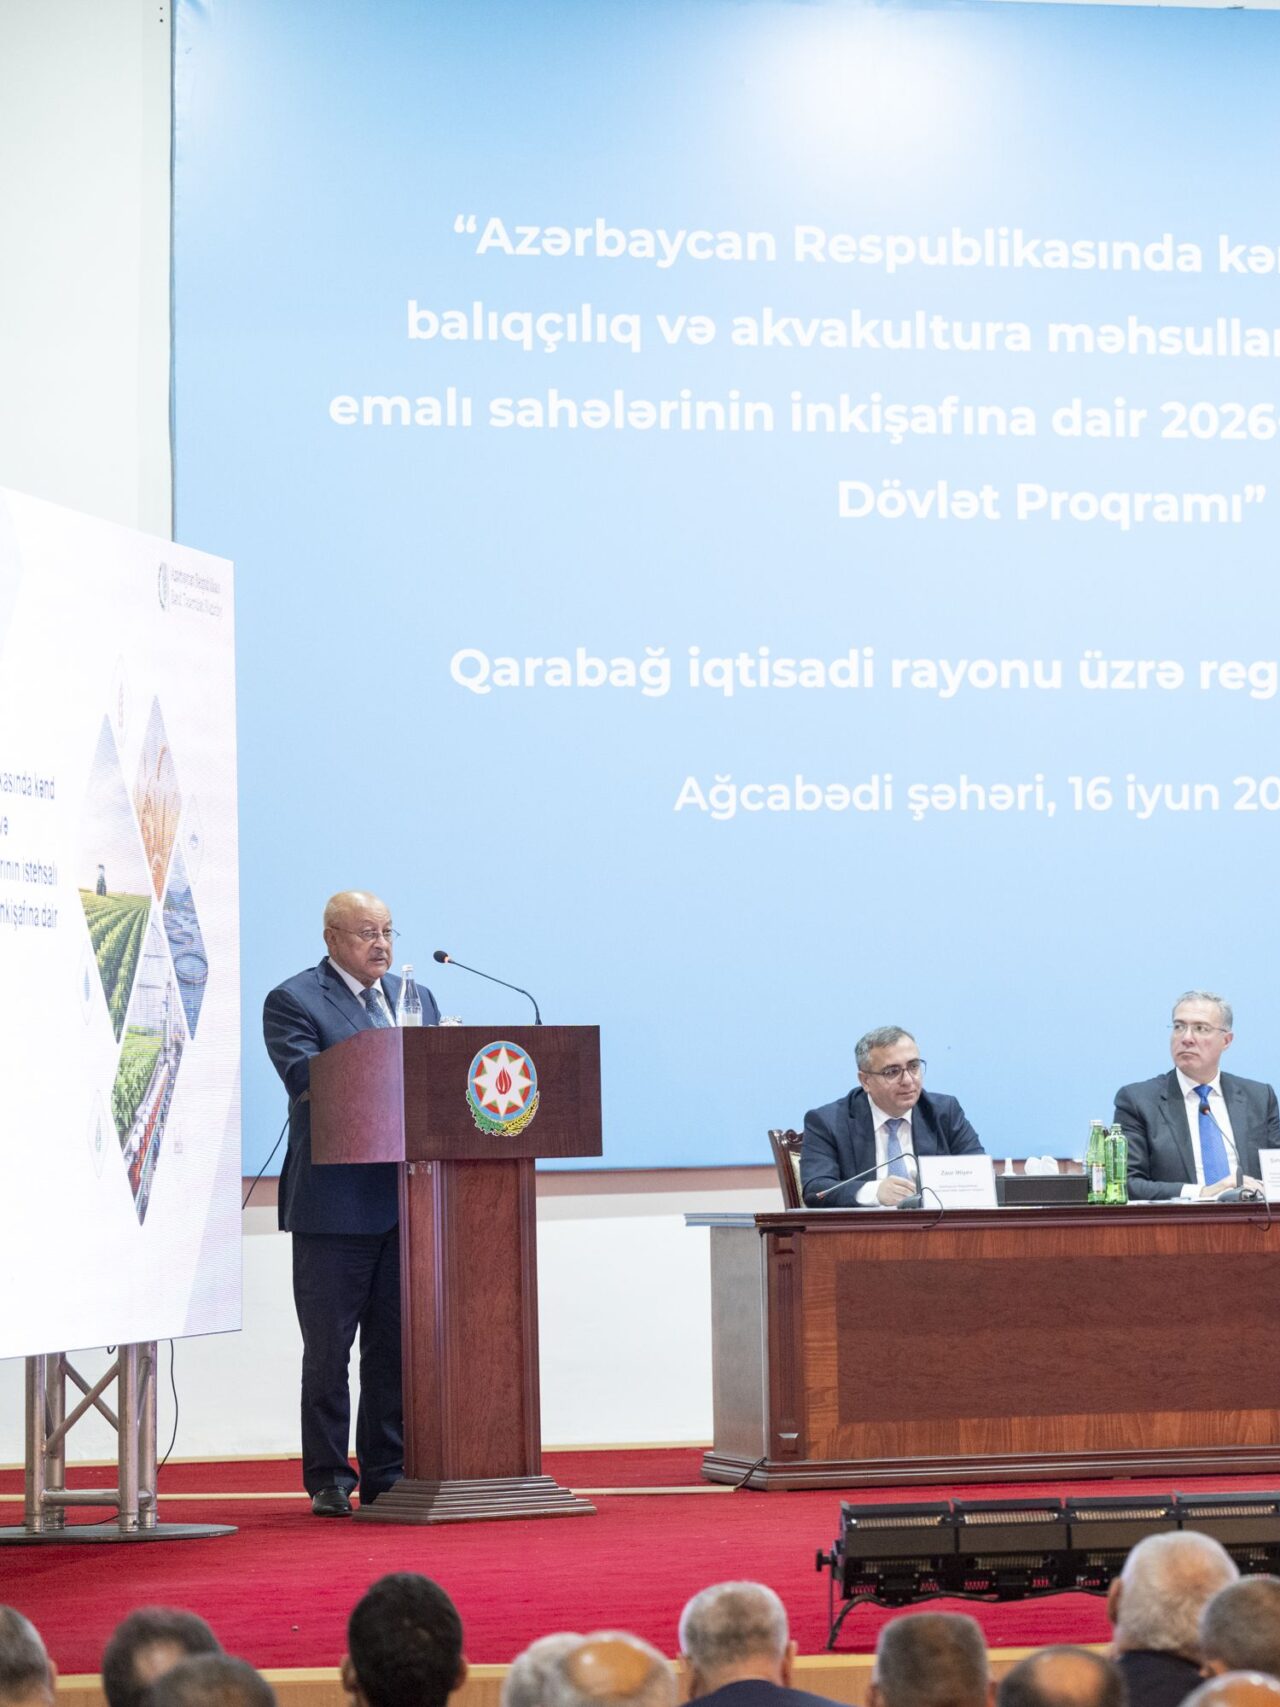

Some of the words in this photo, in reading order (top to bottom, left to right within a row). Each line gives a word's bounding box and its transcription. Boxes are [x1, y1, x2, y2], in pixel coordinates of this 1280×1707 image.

[454, 214, 776, 268] “Azərbaycan
[795, 225, 1202, 273] Respublikasında
[408, 299, 640, 353] balıqçılıq
[656, 315, 716, 345] və
[731, 308, 1031, 351] akvakultura
[329, 386, 471, 427] emalı
[489, 389, 773, 431] sahələrinin
[791, 391, 1036, 444] inkişafına
[1052, 397, 1147, 437] dair
[839, 479, 1000, 519] Dövlət
[1017, 483, 1266, 530] Proqramı”
[450, 646, 671, 697] Qarabağ
[688, 646, 874, 697] iqtisadi
[892, 659, 1062, 698] rayonu
[1080, 650, 1184, 689] üzrə
[35, 772, 55, 799] kənd
[673, 773, 892, 820] Ağcabədi
[908, 774, 1056, 821] şəhəri,
[1068, 776, 1113, 811] 16
[1126, 774, 1220, 819] iyun
[22, 857, 57, 886] istehsalı
[42, 902, 58, 929] dair
